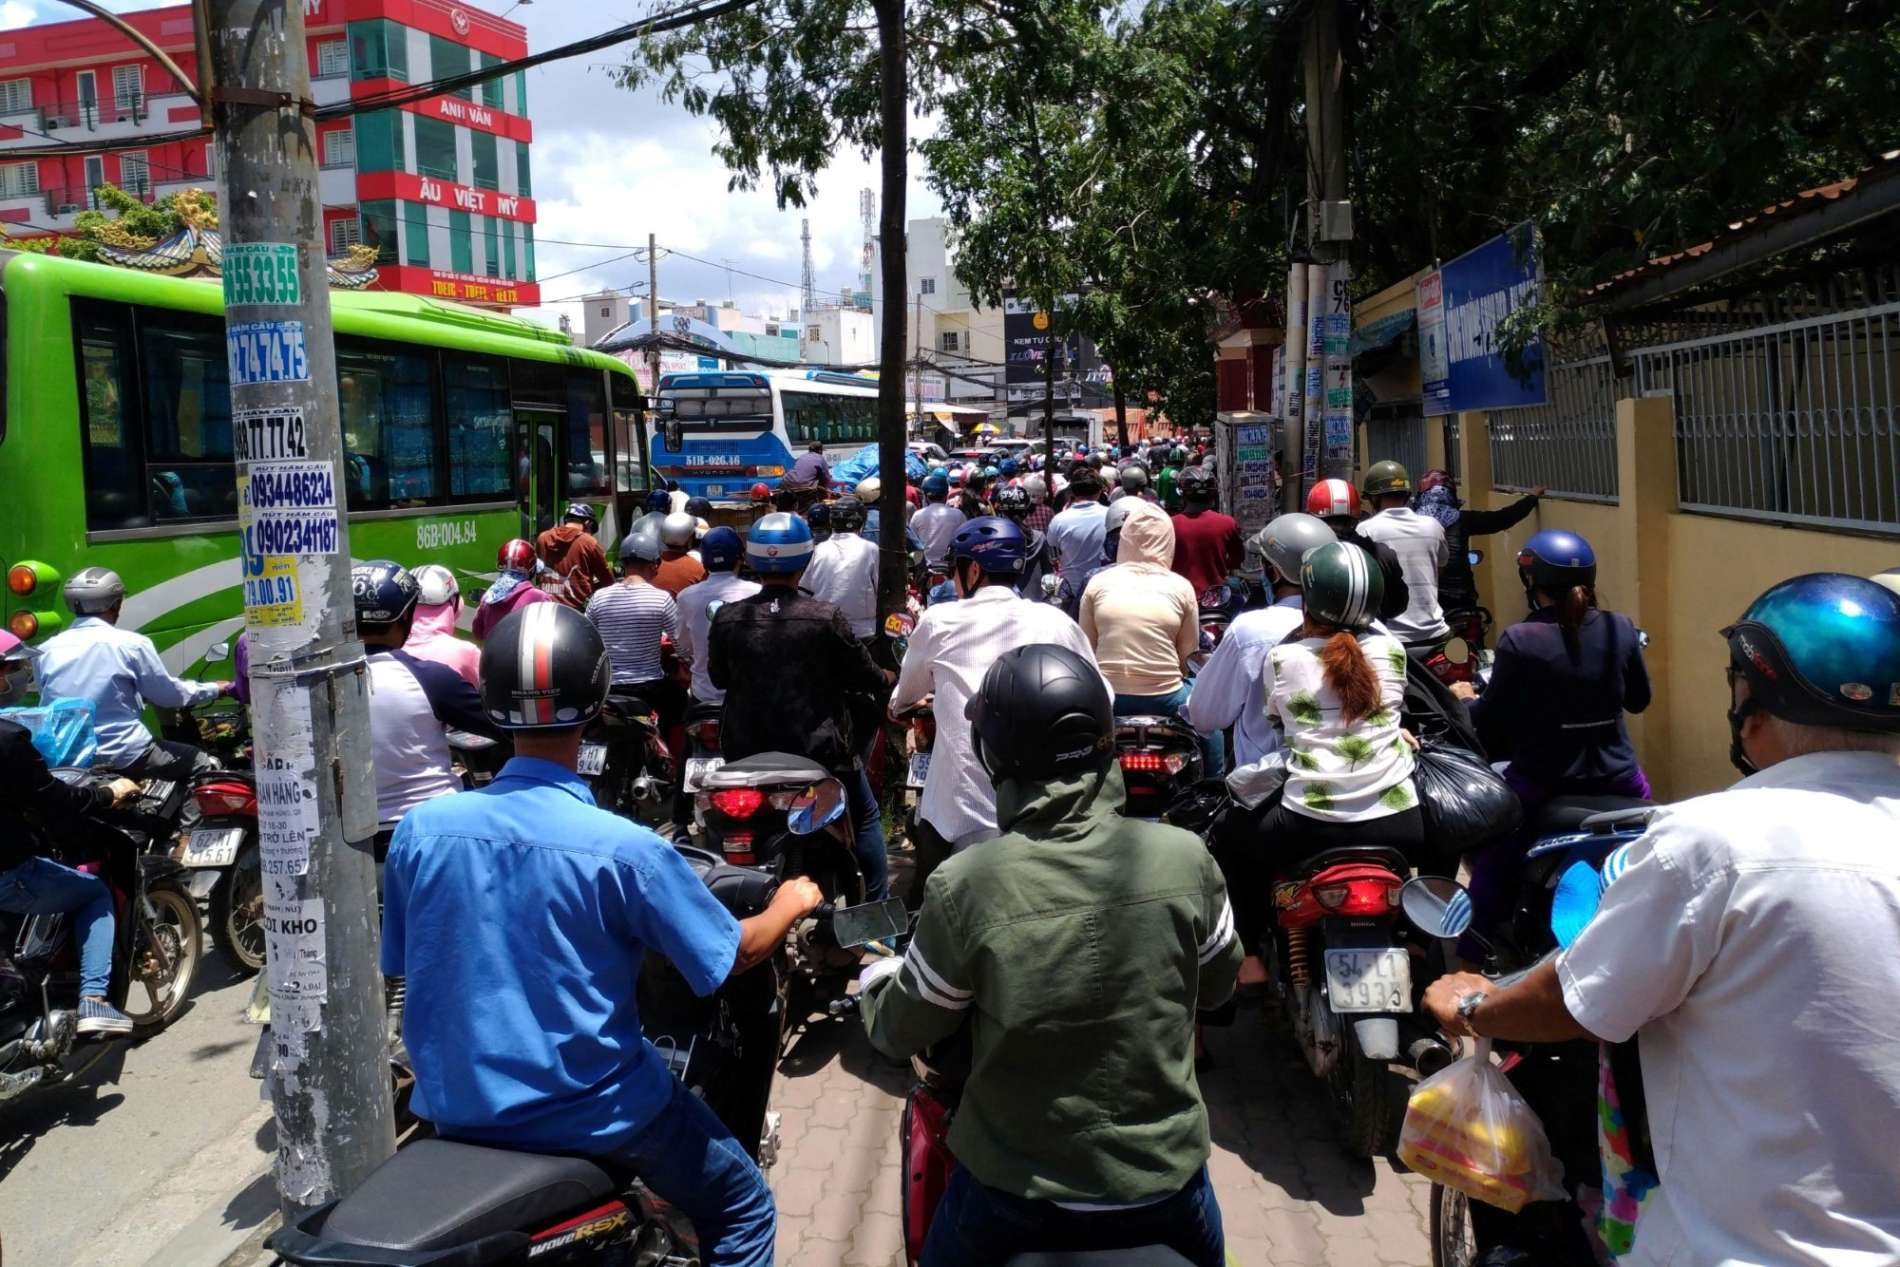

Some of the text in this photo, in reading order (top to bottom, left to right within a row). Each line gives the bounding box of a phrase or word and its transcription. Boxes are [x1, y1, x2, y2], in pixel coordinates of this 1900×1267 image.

[441, 100, 492, 126] ANH VĂN
[420, 177, 519, 216] ÂU VIỆT MỸ
[251, 472, 332, 508] 0934486234
[257, 518, 337, 554] 0902341187
[416, 519, 477, 550] 86B-004.84
[282, 829, 305, 844] LÊN
[281, 918, 317, 935] KHO
[575, 1211, 627, 1240] RSX
